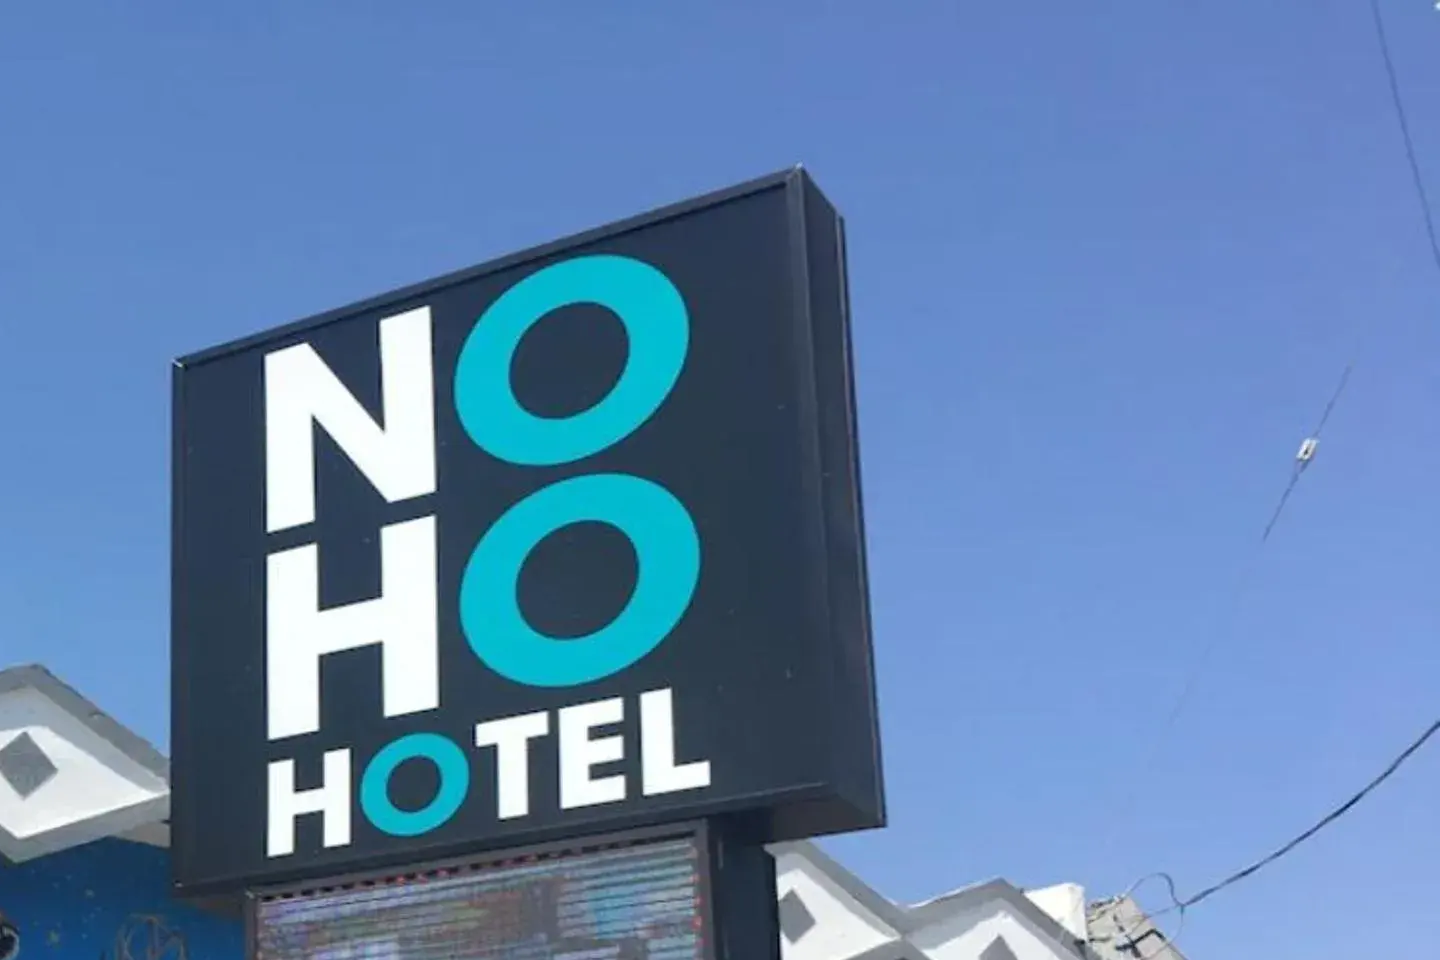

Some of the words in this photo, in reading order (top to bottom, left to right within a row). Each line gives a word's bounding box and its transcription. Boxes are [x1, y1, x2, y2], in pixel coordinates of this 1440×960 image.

[264, 254, 690, 534] NO
[266, 473, 701, 741] HO
[267, 687, 712, 858] HOTEL
